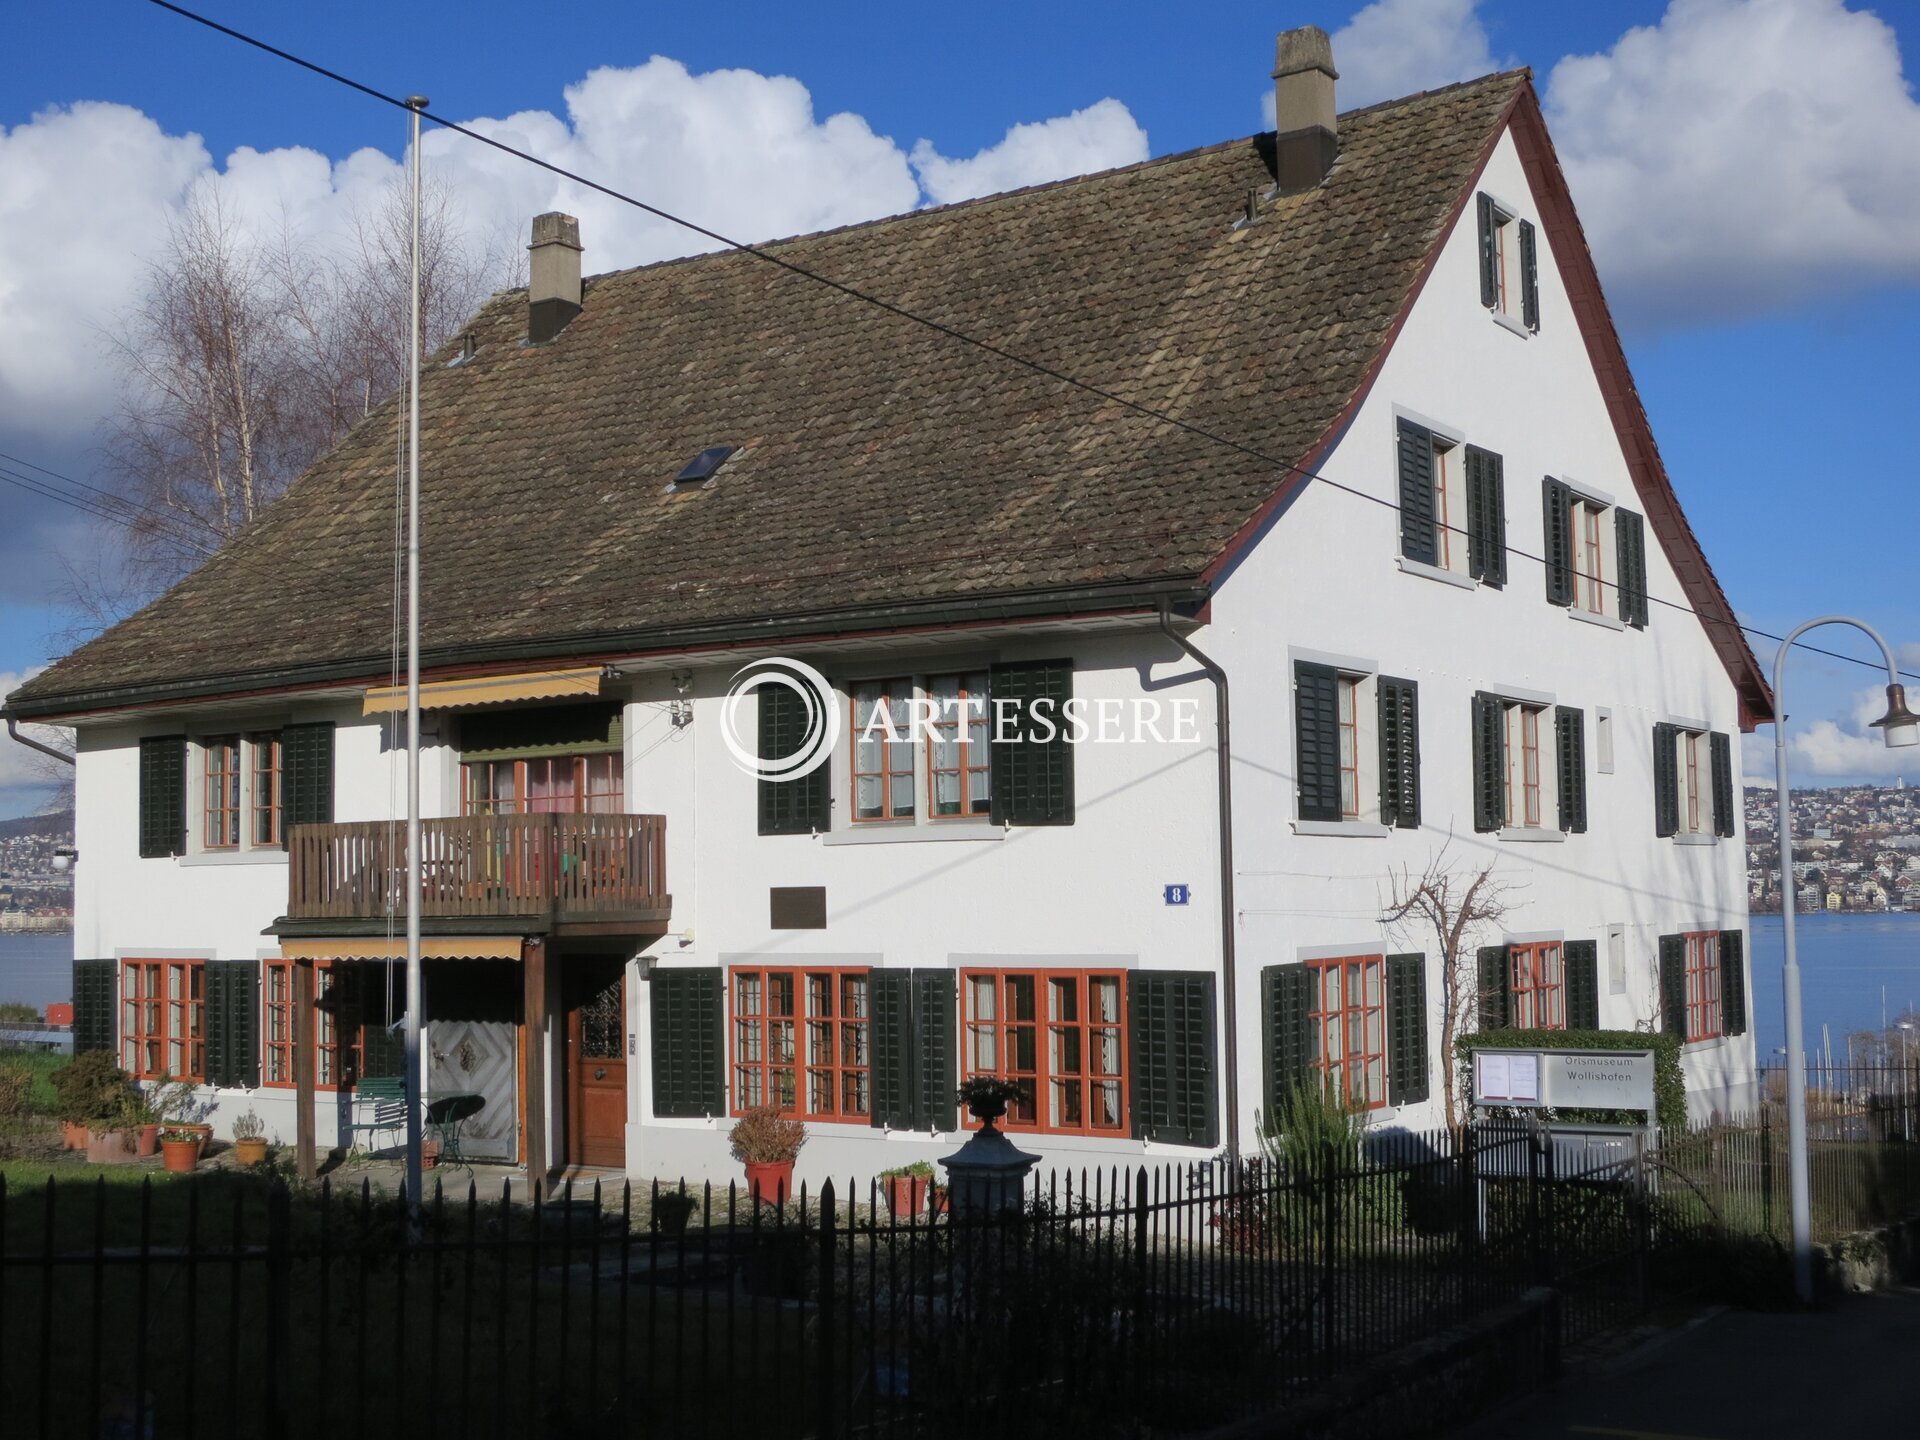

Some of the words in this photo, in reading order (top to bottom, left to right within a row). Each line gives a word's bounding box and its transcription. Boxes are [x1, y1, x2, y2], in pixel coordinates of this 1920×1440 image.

[1172, 887, 1182, 903] 8
[1565, 1056, 1633, 1066] Ortsmuseum
[1567, 1071, 1632, 1081] Wollishofen
